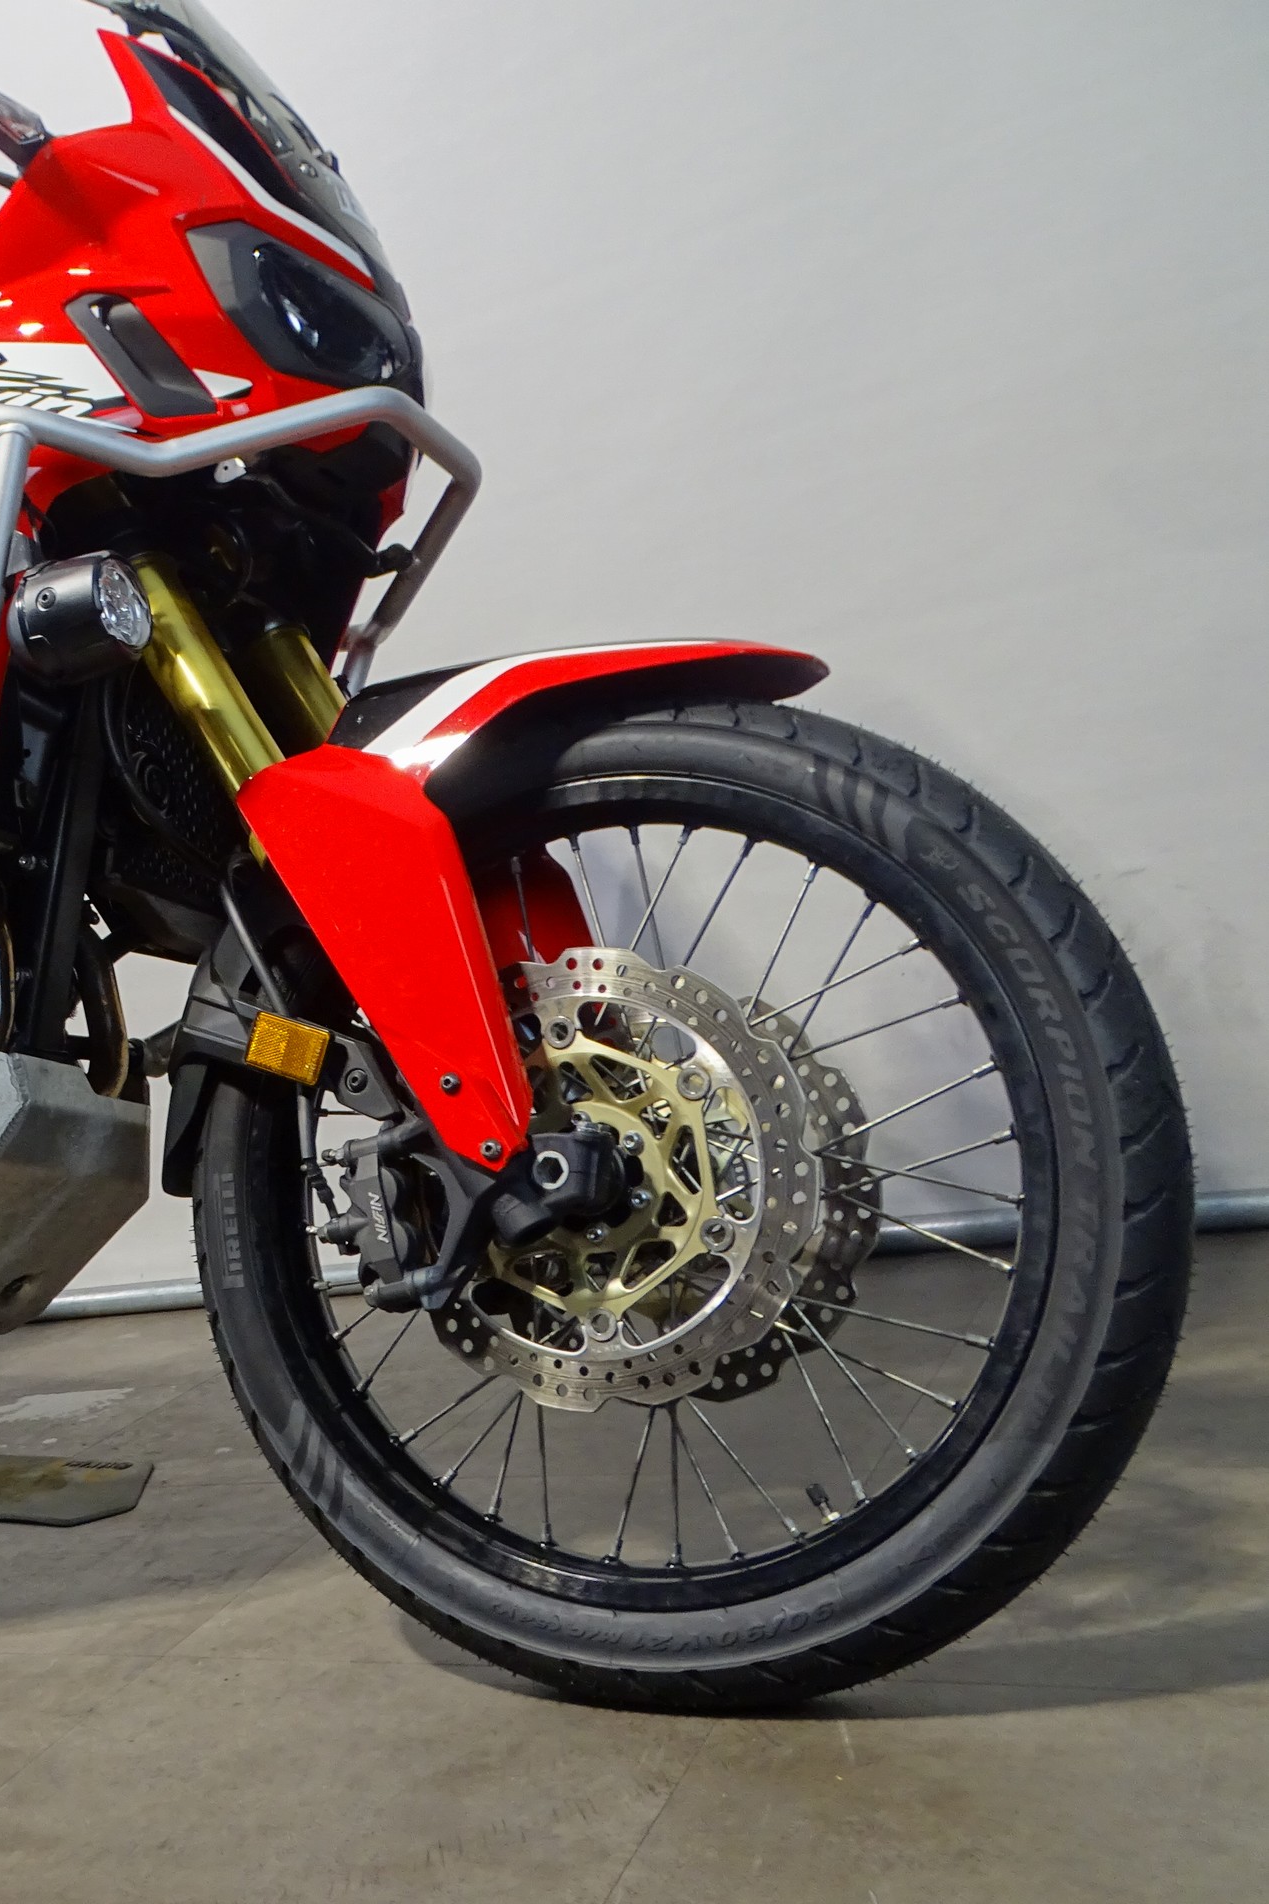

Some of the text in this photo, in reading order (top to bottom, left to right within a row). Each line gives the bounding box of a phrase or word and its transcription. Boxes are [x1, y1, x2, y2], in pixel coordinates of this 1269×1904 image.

[957, 883, 1101, 1172] SCORPION
[212, 1172, 246, 1290] PIRELLI
[367, 1191, 391, 1244] NISSIN
